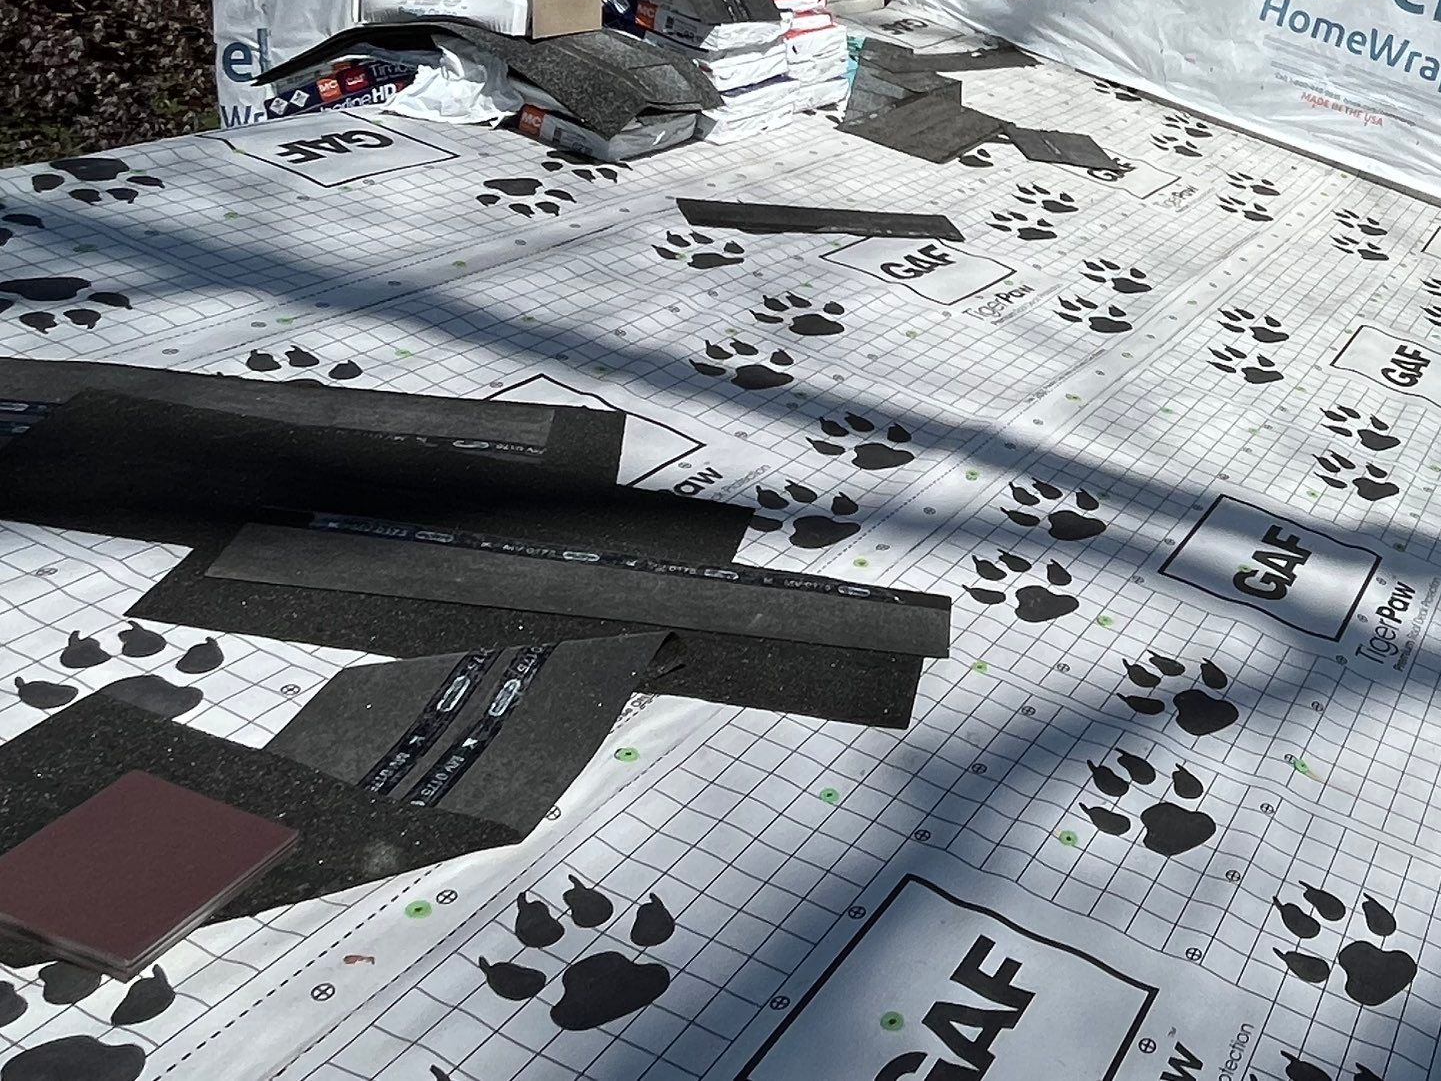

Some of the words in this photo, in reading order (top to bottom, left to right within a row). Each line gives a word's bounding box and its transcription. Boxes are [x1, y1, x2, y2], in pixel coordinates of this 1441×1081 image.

[1300, 91, 1329, 108] MADE
[1331, 102, 1343, 112] IN
[1343, 106, 1361, 118] THE
[1363, 113, 1384, 126] USA
[276, 130, 394, 164] GAF
[880, 244, 957, 281] GAF
[962, 283, 1035, 324] TigerPaw
[1381, 345, 1431, 388] GAF
[1233, 524, 1312, 601] GAF
[1355, 581, 1416, 665] TigerPaw
[1218, 1022, 1255, 1081] otection
